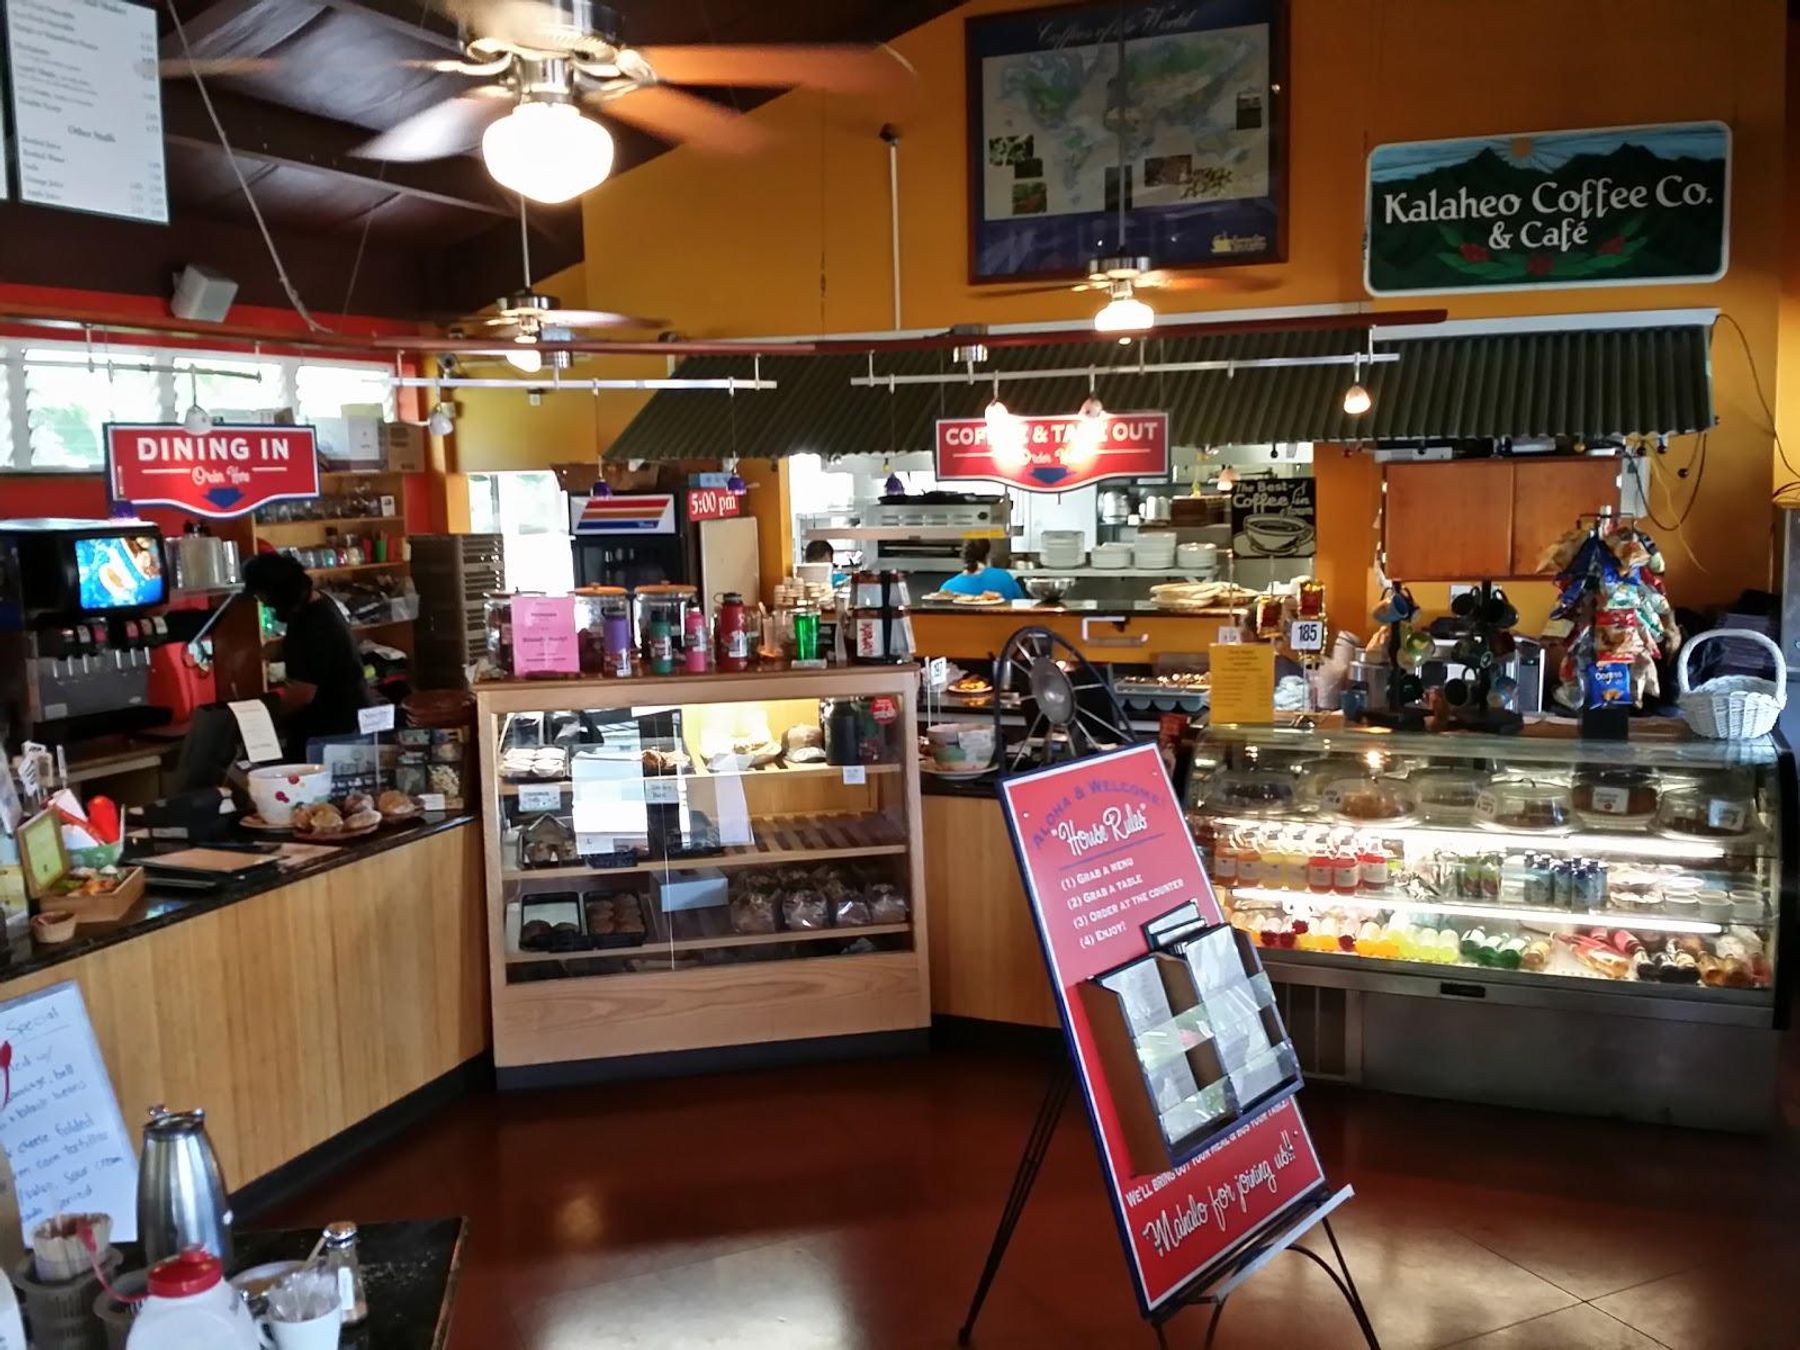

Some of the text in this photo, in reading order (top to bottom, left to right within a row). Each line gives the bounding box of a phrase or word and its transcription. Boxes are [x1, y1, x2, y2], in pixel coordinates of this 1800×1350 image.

[1385, 175, 1713, 223] Kalaheo Coffee Co.
[1488, 218, 1589, 252] & Café
[1032, 424, 1048, 442] &
[1112, 422, 1158, 442] OUT
[136, 437, 290, 461] DINING IN
[691, 492, 737, 517] 5:00 pm
[1232, 493, 1289, 514] Coffee
[1074, 785, 1086, 800] &
[1061, 877, 1077, 891] (1)
[1102, 866, 1111, 875] A
[1067, 896, 1082, 910] (2)
[1109, 884, 1117, 894] A
[1073, 915, 1089, 929] (3)
[1119, 900, 1131, 910] AT
[1131, 892, 1149, 905] THE
[1079, 935, 1096, 949] (4)
[1125, 1183, 1153, 1208] WE'LL
[1151, 1171, 1176, 1191] BRING
[1207, 1184, 1236, 1231] for
[1233, 1160, 1277, 1213] joining
